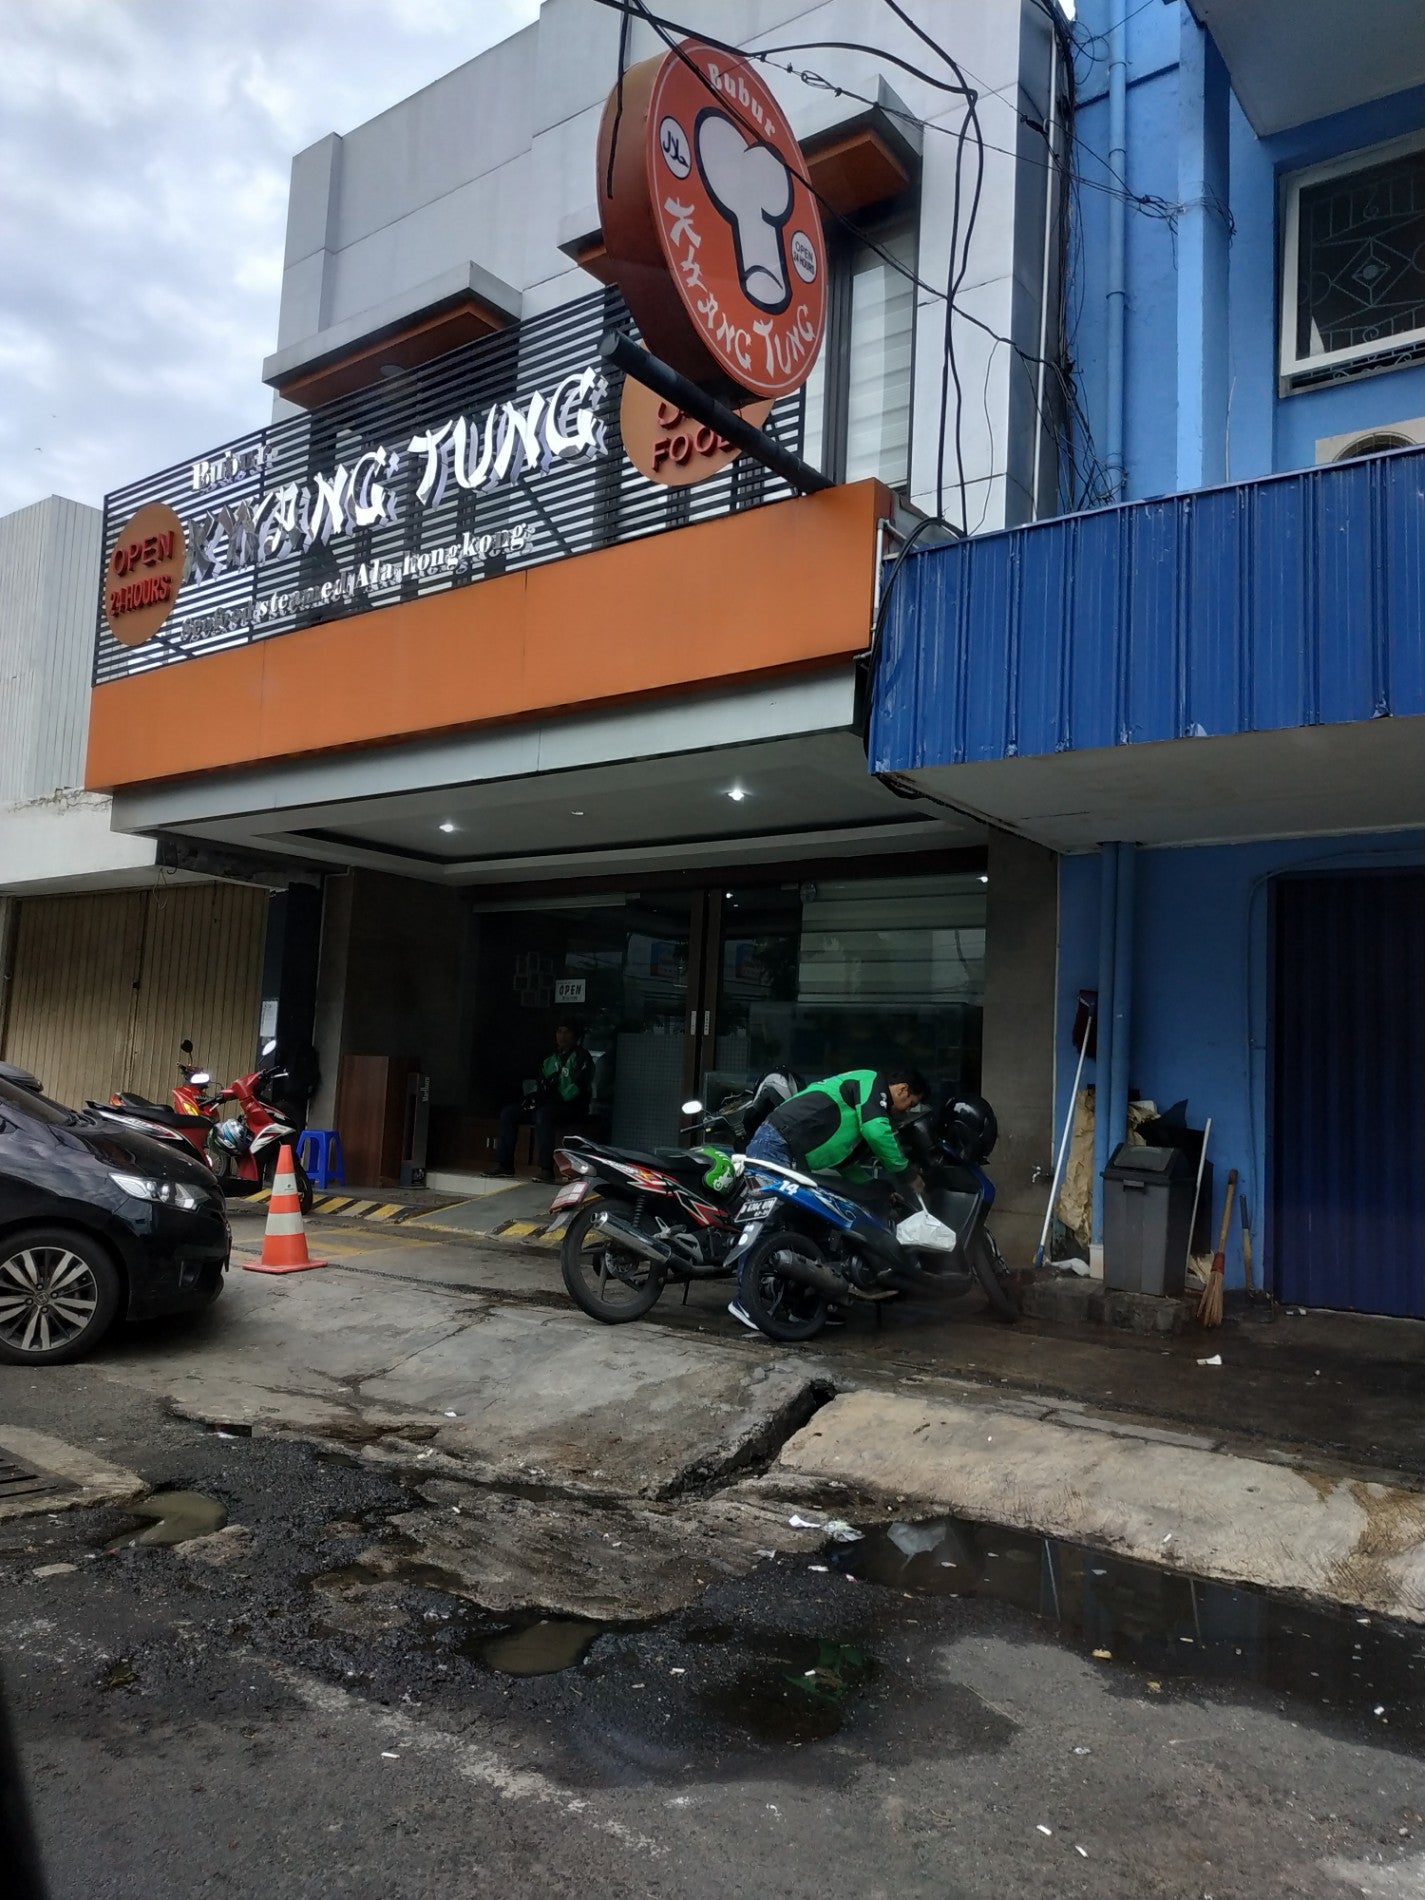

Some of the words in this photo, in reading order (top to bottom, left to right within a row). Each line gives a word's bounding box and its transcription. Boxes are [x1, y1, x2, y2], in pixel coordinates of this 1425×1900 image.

[707, 63, 776, 137] Bubur
[662, 130, 690, 169] حلال
[795, 240, 814, 263] OPEN
[752, 304, 816, 378] TUNG
[183, 445, 392, 585] KWANG
[406, 366, 598, 506] TUNG
[192, 444, 272, 491] Bubur
[112, 529, 175, 577] OPEN
[126, 573, 172, 610] HOURS
[356, 558, 394, 589] Ala
[558, 984, 582, 996] OPEN
[779, 1180, 799, 1196] 14
